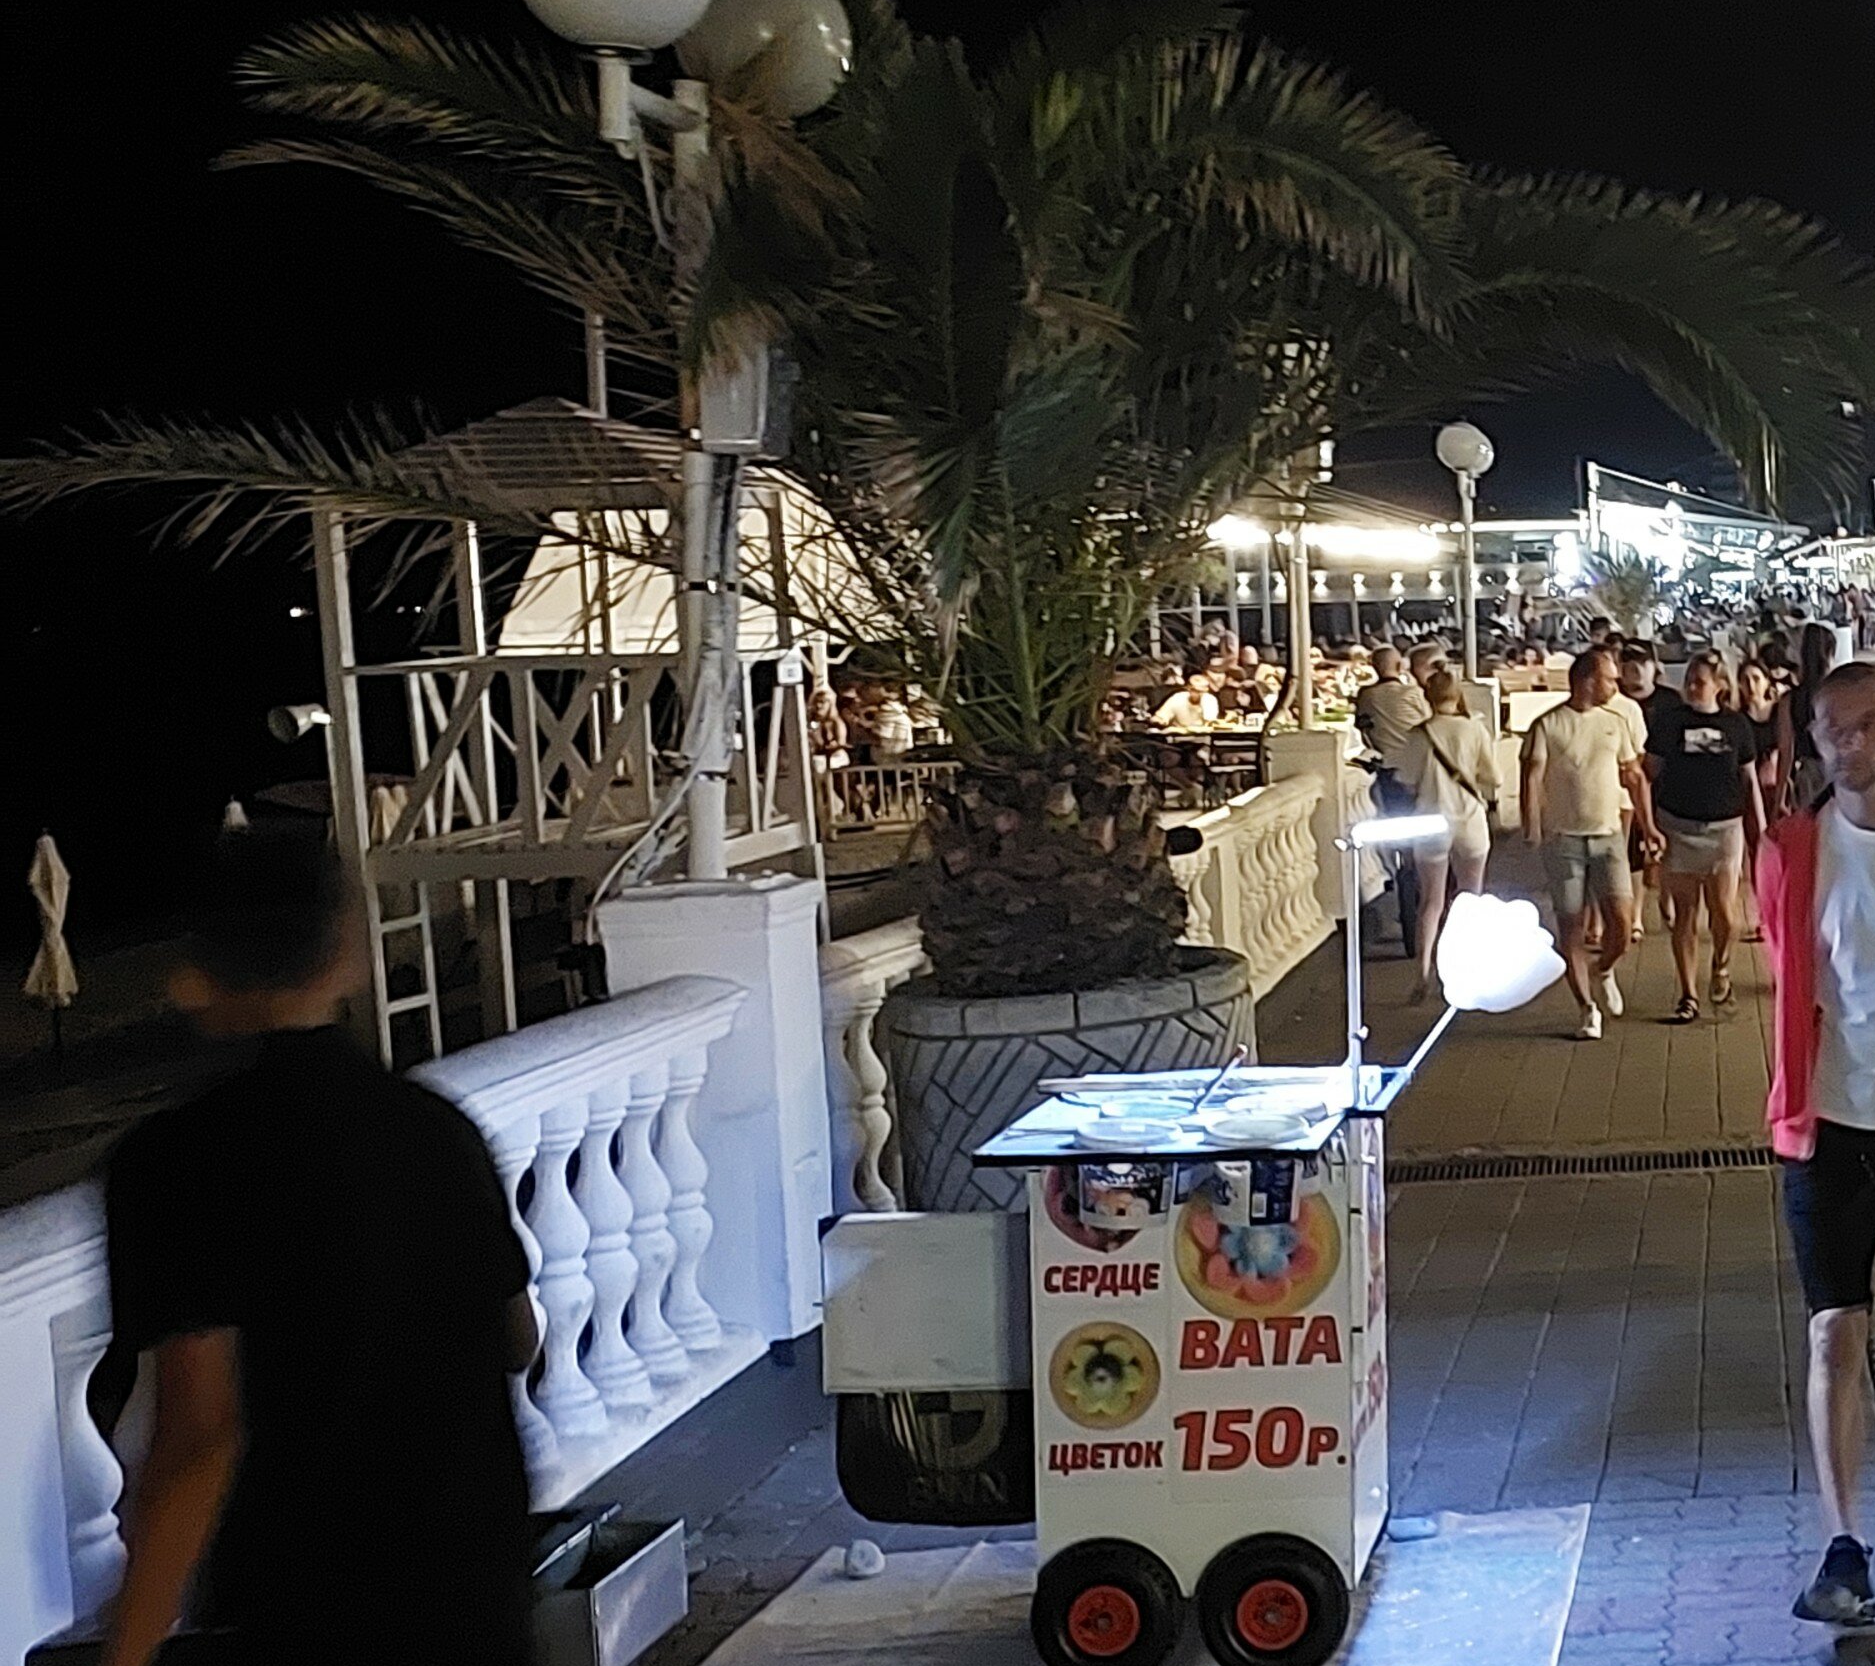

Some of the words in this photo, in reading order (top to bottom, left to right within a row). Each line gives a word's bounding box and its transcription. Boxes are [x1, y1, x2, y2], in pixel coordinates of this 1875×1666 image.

[1044, 1263, 1160, 1297] СЕРДЦЕ
[1179, 1315, 1342, 1370] ВАТА
[1048, 1441, 1163, 1476] ЦВЕТОК
